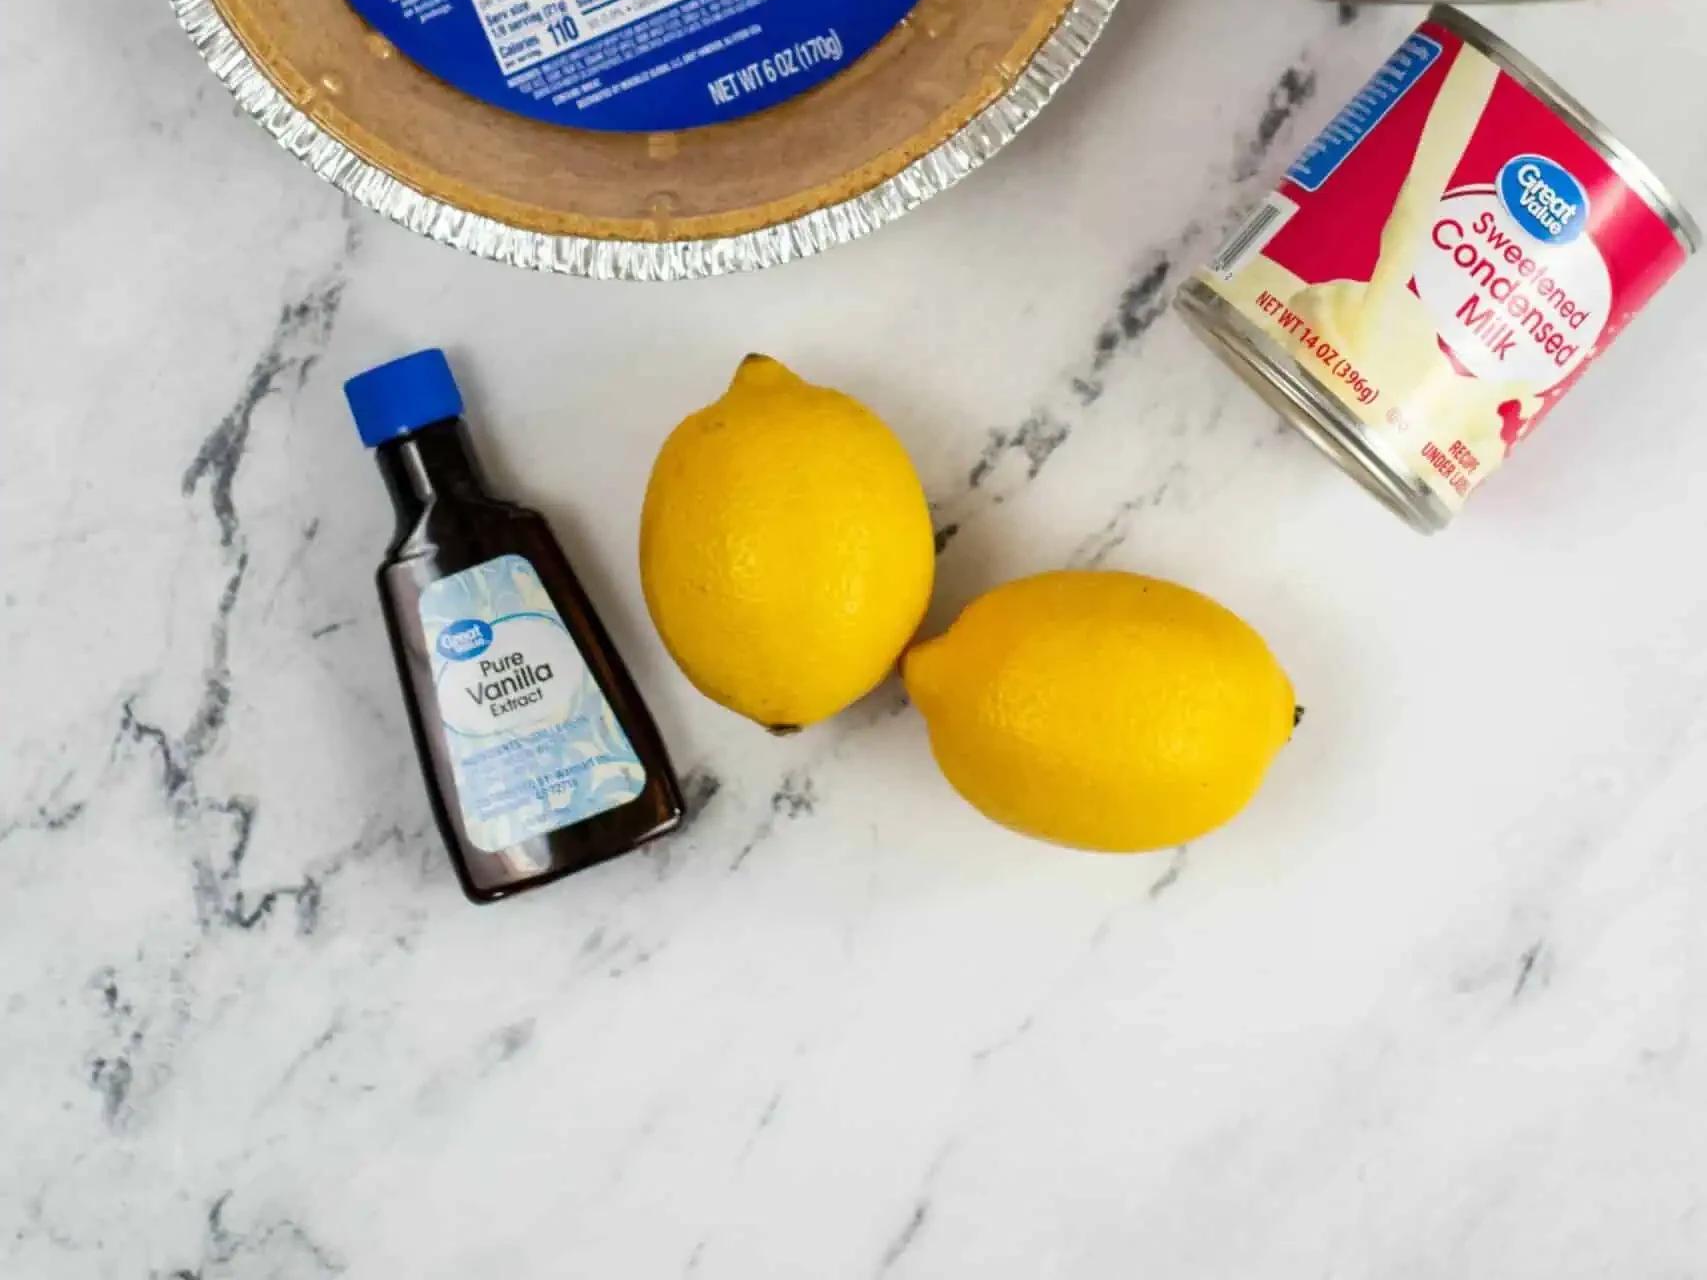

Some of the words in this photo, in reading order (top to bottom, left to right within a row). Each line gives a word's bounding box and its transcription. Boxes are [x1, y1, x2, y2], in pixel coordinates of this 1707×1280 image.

[546, 16, 580, 45] 110
[707, 72, 740, 106] NET
[736, 61, 765, 93] WT
[762, 58, 777, 83] 6
[774, 48, 800, 78] OZ
[794, 28, 844, 71] (170g)
[1518, 164, 1577, 224] Great
[1519, 189, 1562, 235] Value
[1431, 217, 1579, 366] Condensed
[1472, 211, 1592, 330] Sweetened
[1256, 290, 1284, 316] NET
[1277, 308, 1304, 334] WT
[1299, 327, 1320, 350] 14
[1315, 343, 1340, 366] OZ
[1331, 358, 1380, 405] (396g)
[1456, 292, 1517, 361] Milk
[1421, 440, 1457, 480] UNDER
[465, 663, 554, 705] Vanilla
[479, 652, 524, 677] Pure
[490, 687, 543, 719] Extract
